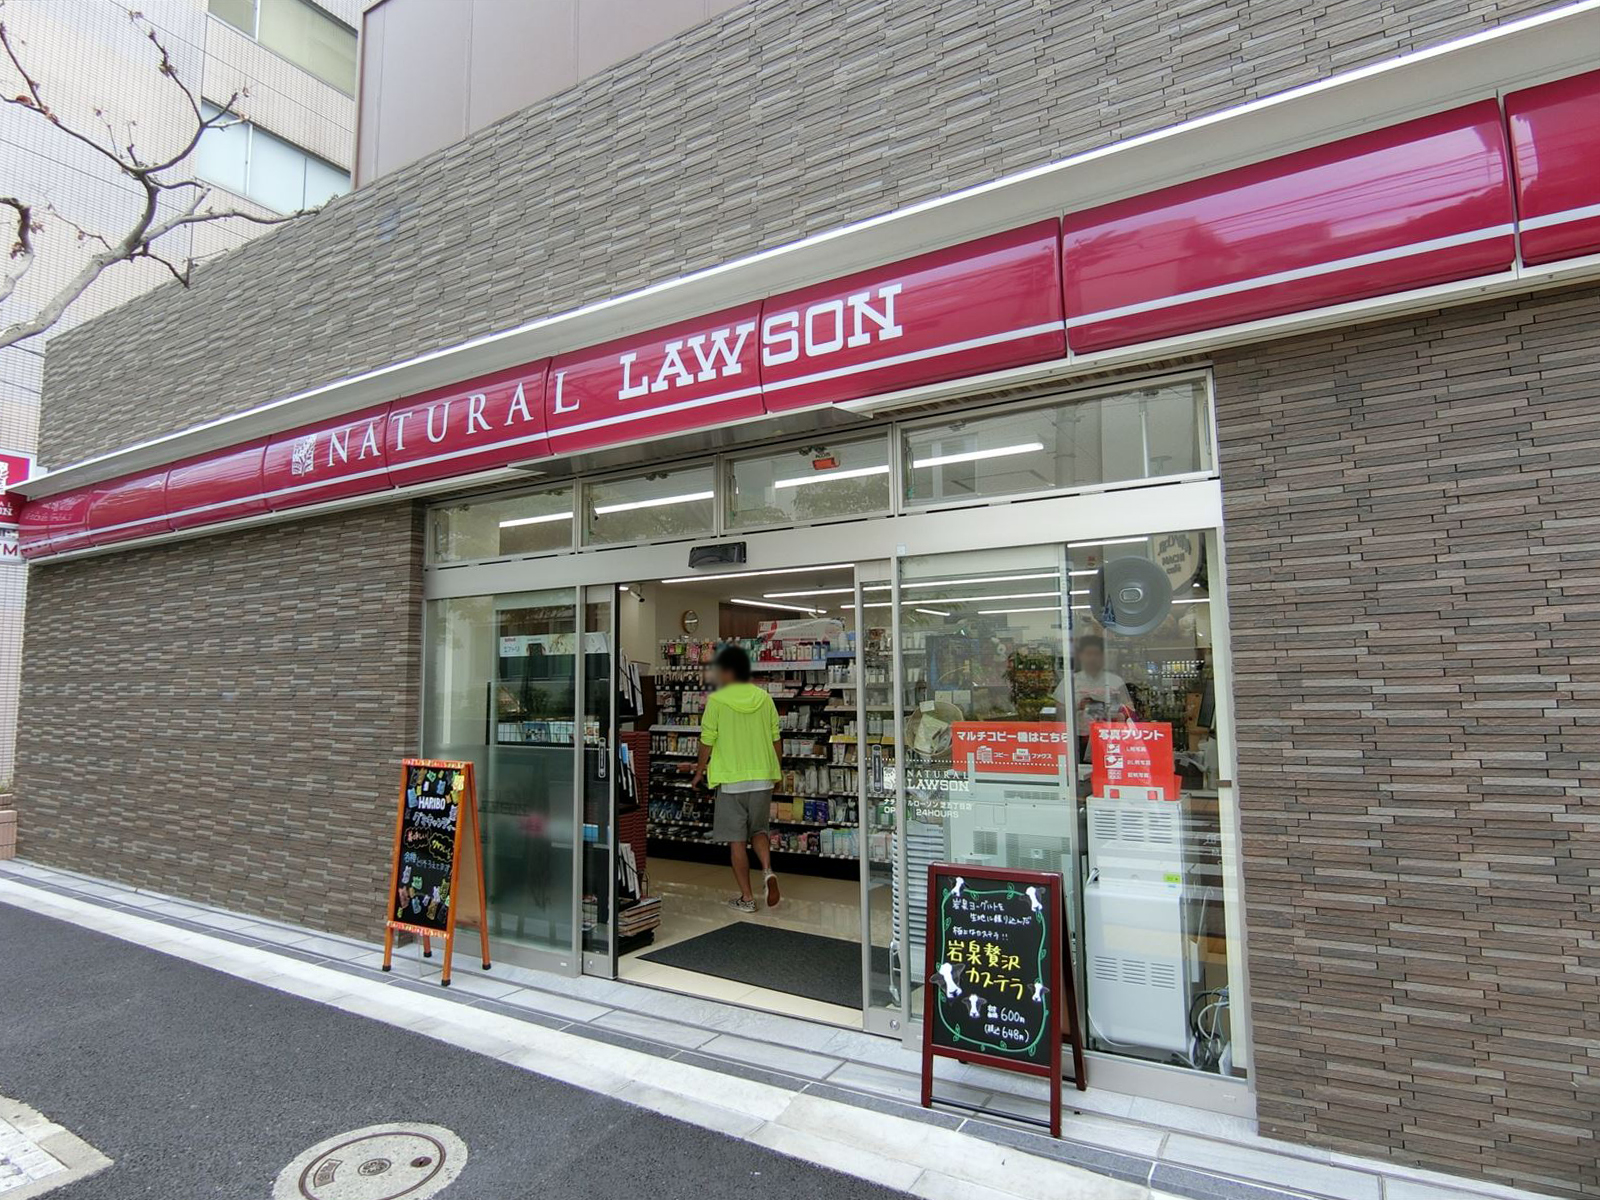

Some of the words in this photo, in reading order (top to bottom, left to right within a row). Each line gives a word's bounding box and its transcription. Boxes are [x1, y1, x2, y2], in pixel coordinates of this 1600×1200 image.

[327, 371, 580, 467] NATURAL
[618, 283, 903, 400] LAWSON
[1098, 729, 1165, 741] 写真プリント
[906, 769, 969, 780] NATURAL
[906, 779, 970, 792] LAWSON
[418, 796, 446, 810] HARIBO
[916, 809, 959, 818] 24HOURS
[947, 940, 1021, 970] 岩泉贅沢
[965, 967, 1023, 1000] カステラ
